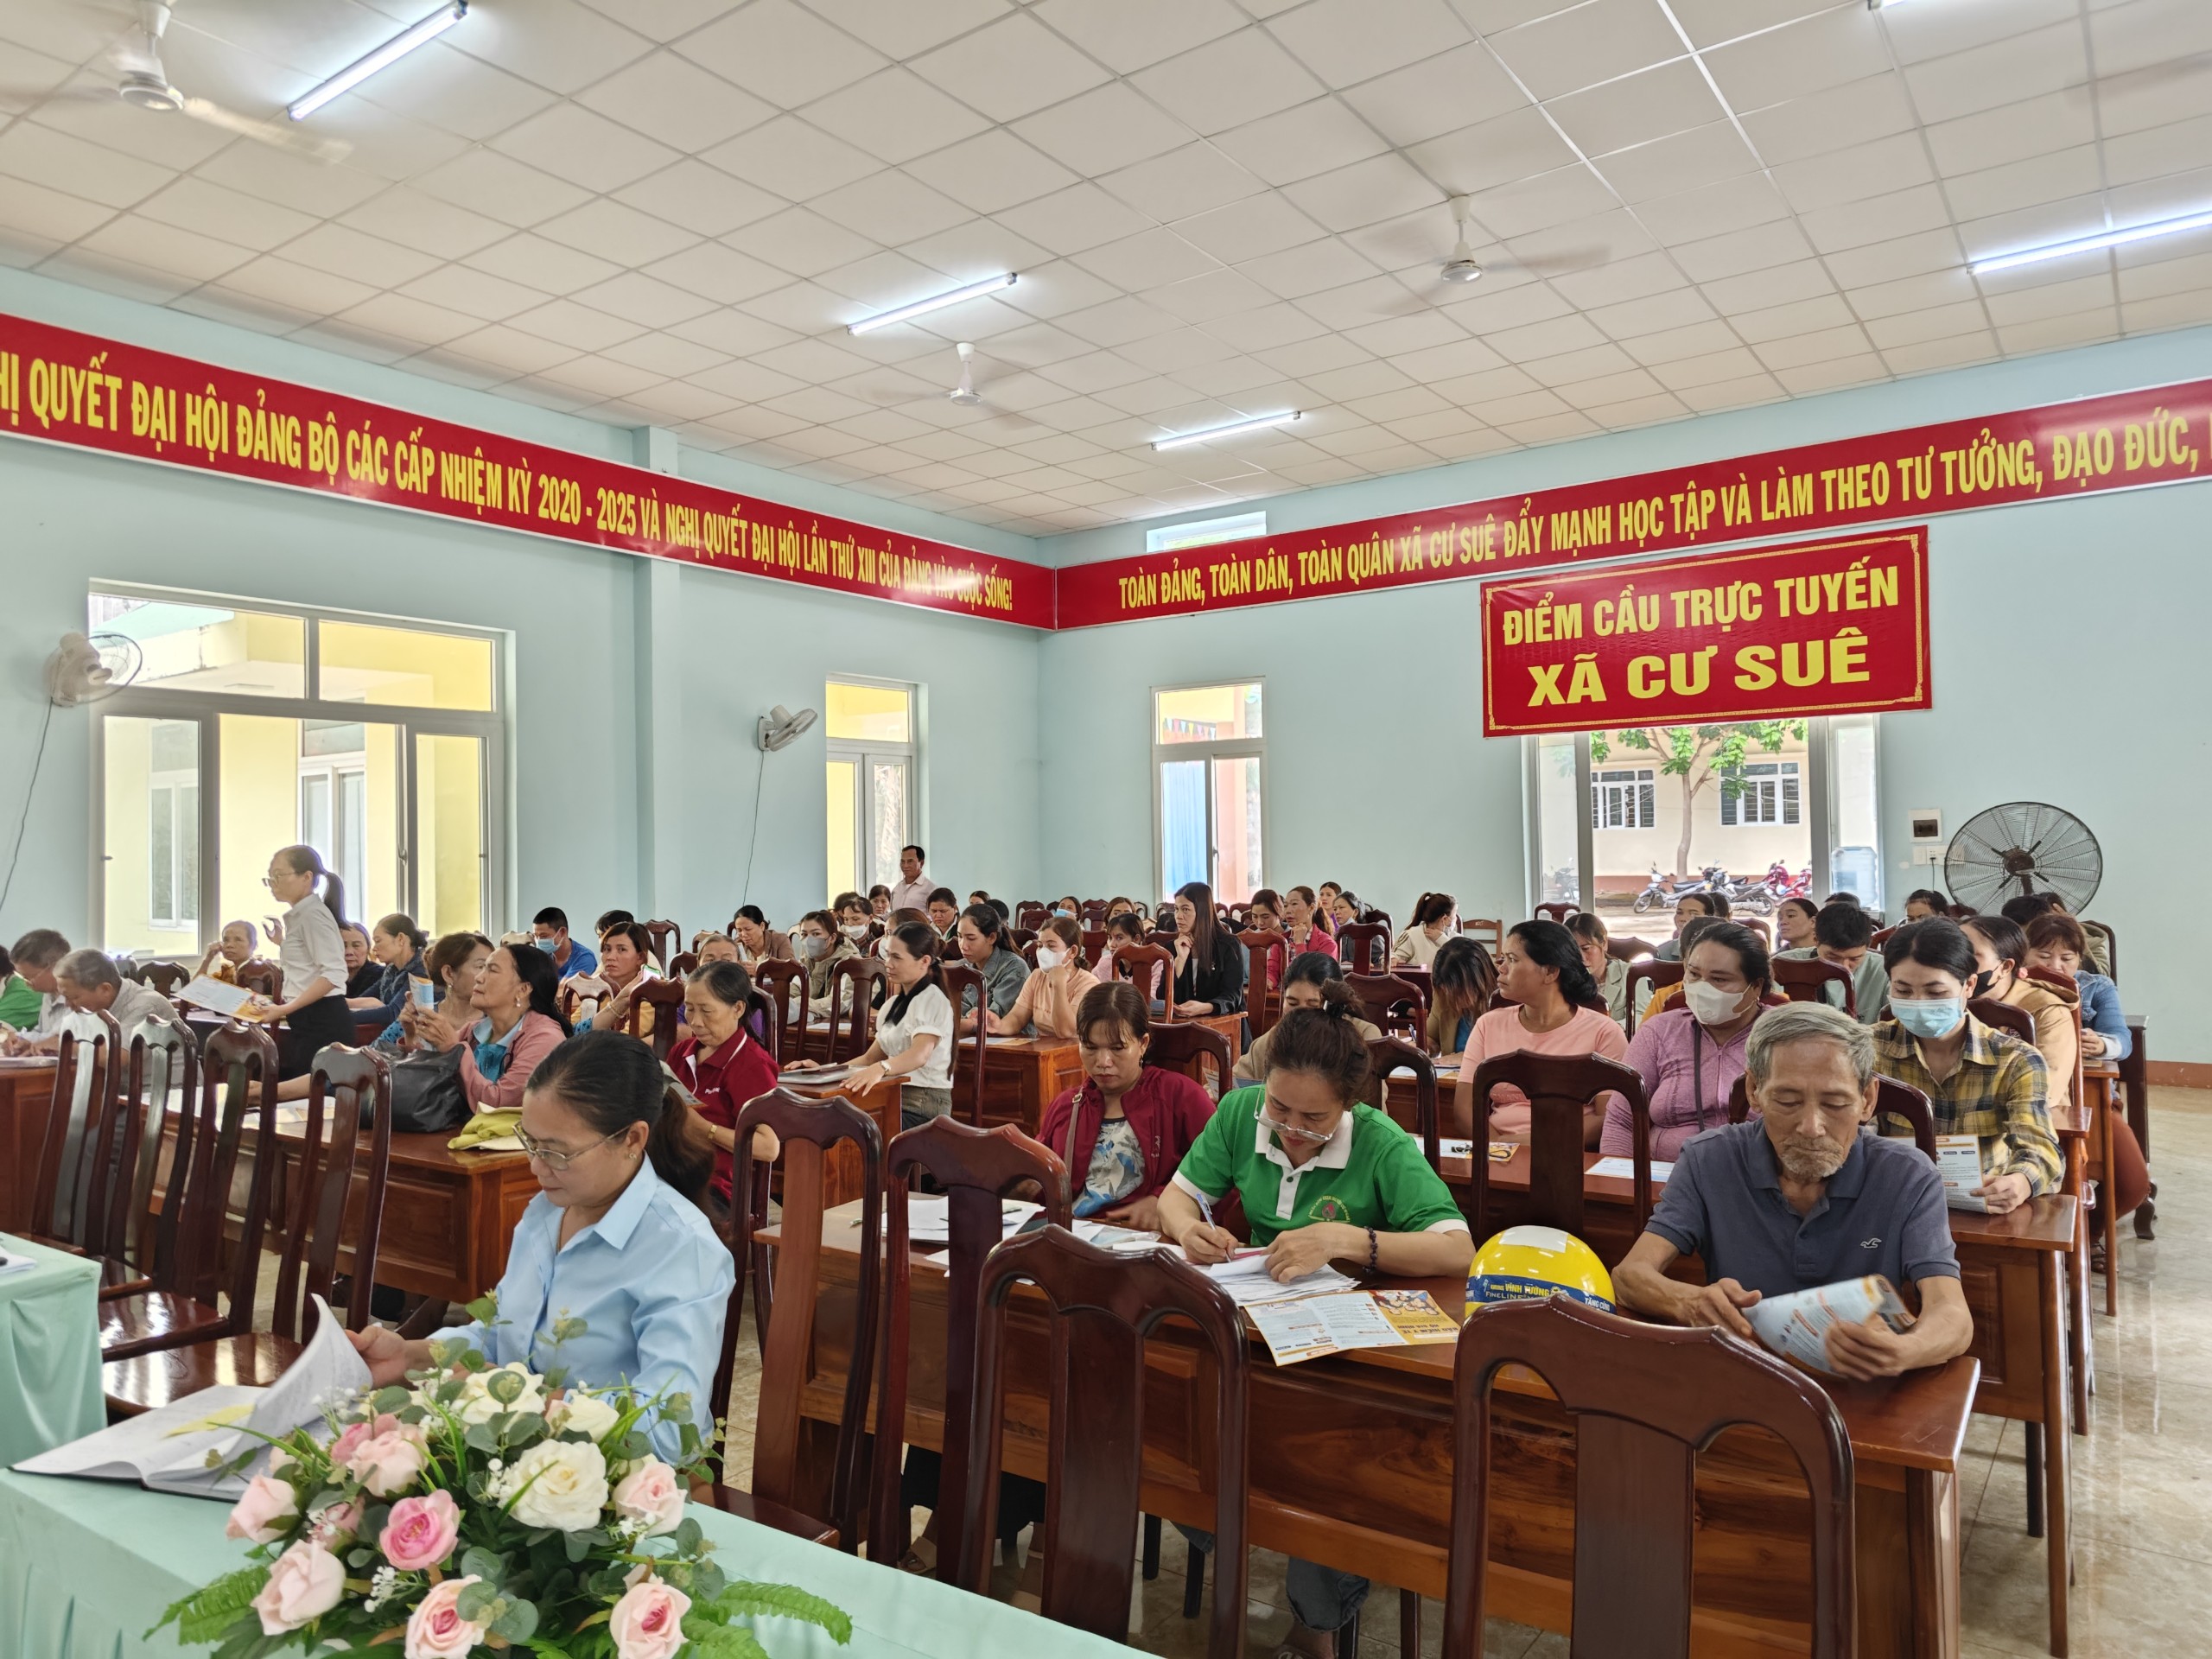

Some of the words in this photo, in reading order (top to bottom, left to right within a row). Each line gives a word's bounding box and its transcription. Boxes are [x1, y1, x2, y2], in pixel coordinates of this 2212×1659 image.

[29, 351, 123, 431] QUYẾT
[130, 380, 176, 452] ĐẠI
[186, 382, 229, 462] HỘI
[236, 388, 302, 468] ĐẢNG
[308, 410, 340, 486] BỘ
[346, 419, 389, 486] CÁC
[394, 426, 435, 493] CẤP
[441, 446, 502, 515] NHIỆM
[508, 457, 531, 514] KỲ
[538, 474, 582, 524] 2020
[596, 487, 637, 536] 2025
[640, 488, 661, 541] VÀ
[665, 503, 701, 560] NGHỊ
[702, 503, 748, 559] QUYẾT
[752, 522, 775, 571] ĐẠI
[778, 520, 800, 575] HỘI
[804, 520, 828, 575] LẦN
[830, 534, 855, 580] THỨ
[857, 545, 876, 584] XIII
[878, 539, 902, 589] CỦA
[903, 544, 933, 594] ĐẢNG
[984, 563, 1012, 610] SỐNG!
[1119, 566, 1158, 609] TOÀN
[1160, 557, 1205, 606] ĐẢNG,
[1209, 554, 1250, 596] TOÀN
[1255, 547, 1294, 594] DÂN,
[1297, 540, 1342, 585] TOÀN
[1347, 531, 1395, 586] QUÂN
[1399, 524, 1424, 572] XÃ
[1428, 522, 1457, 569] CƯ
[1459, 513, 1497, 564] SUÊ
[1503, 497, 1544, 558] ĐẨY
[1551, 505, 1611, 556] MẠNH
[1619, 496, 1664, 548] HỌC
[1669, 480, 1716, 540] TẬP
[1720, 473, 1752, 526] VÀ
[1761, 467, 1814, 521] LÀM
[1821, 461, 1890, 512] THEO
[1897, 446, 1935, 501] TƯ
[1940, 428, 2044, 495] TƯỞNG,
[2051, 427, 2115, 487] ĐẠO
[2123, 404, 2199, 474] ĐỨC,
[1502, 591, 1583, 645] ĐIỂM
[1593, 583, 1661, 637] CẦU
[1669, 580, 1763, 632] TRỰC
[1774, 556, 1898, 618] TUYẾN
[1528, 652, 1606, 707] XÃ
[1627, 645, 1719, 699] CƯ
[1734, 626, 1870, 691] SUÊ
